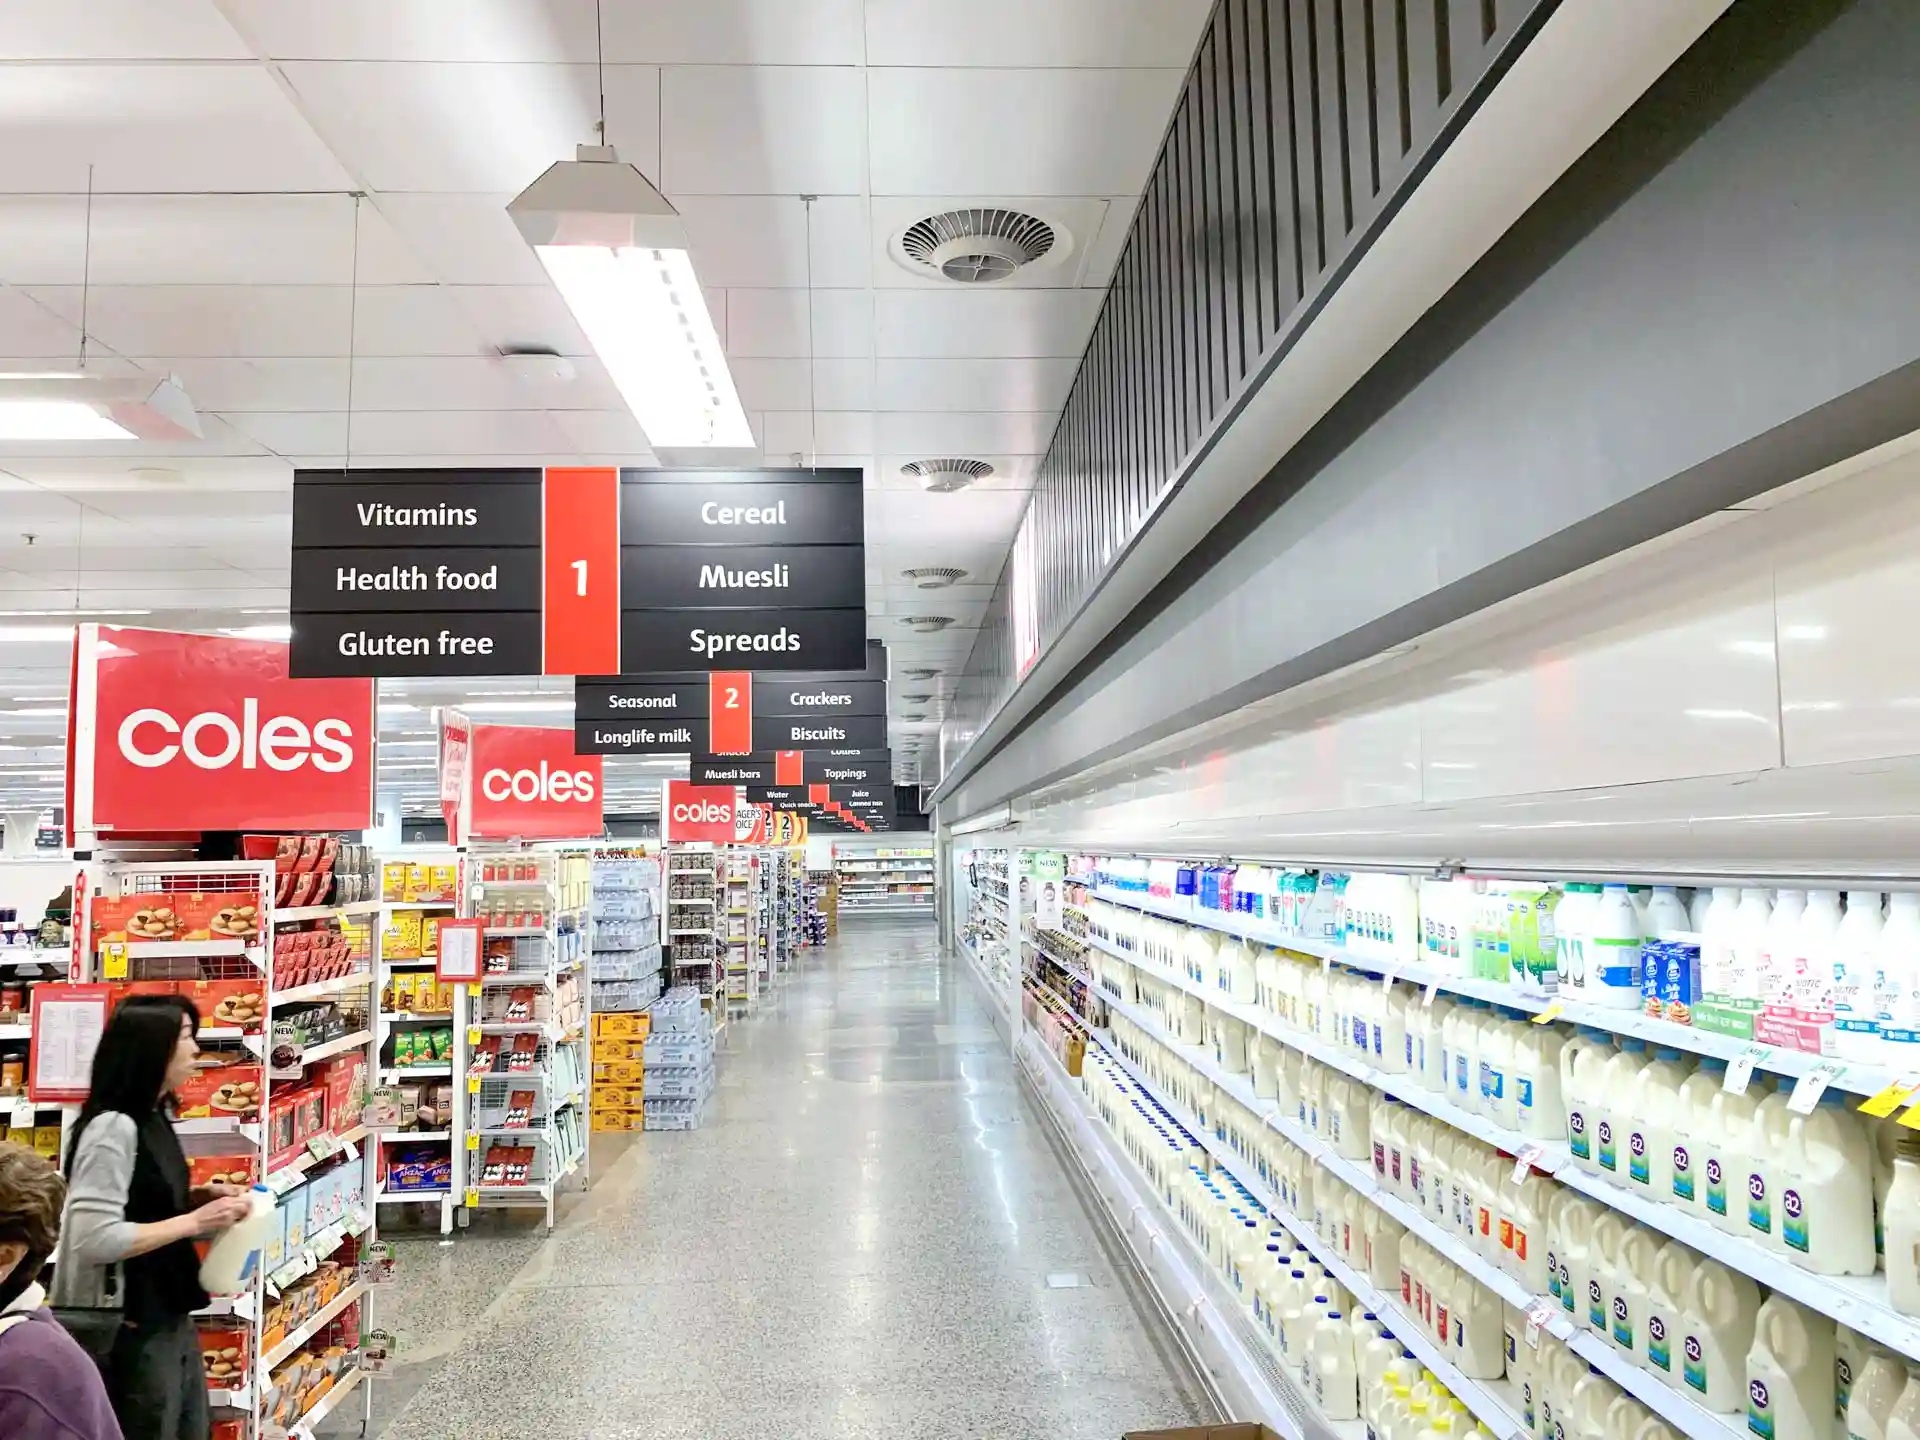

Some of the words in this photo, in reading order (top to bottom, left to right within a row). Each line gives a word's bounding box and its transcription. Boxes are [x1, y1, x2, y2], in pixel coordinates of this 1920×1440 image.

[356, 502, 478, 526] Vitamins
[701, 501, 787, 525] Cereal
[336, 567, 428, 591] Health
[436, 564, 498, 590] food
[571, 559, 589, 596] 1
[698, 563, 789, 588] Muesli
[338, 632, 431, 657] Gluten
[437, 629, 494, 655] free
[690, 627, 801, 658] Spreads
[608, 693, 678, 708] Seasonal
[725, 687, 739, 708] 2
[790, 691, 852, 706] Crackers
[117, 697, 354, 773] coles
[594, 729, 656, 747] Longlife
[659, 728, 692, 742] milk
[791, 727, 846, 741] Biscuits
[482, 760, 595, 803] coles
[705, 769, 737, 779] Muesli
[739, 769, 761, 779] bars
[824, 768, 867, 780] Toppings
[766, 791, 789, 799] Water
[852, 790, 870, 798] Juice
[673, 798, 731, 823] coles
[782, 816, 790, 830] 2
[1040, 859, 1058, 868] NEW
[274, 1027, 295, 1035] NEW
[373, 1089, 391, 1097] NEW
[1571, 1115, 1583, 1132] a2
[1600, 1125, 1611, 1142] a2
[1632, 1138, 1644, 1154] a2
[1674, 1151, 1689, 1168] a2
[1707, 1163, 1721, 1181] a2
[1750, 1179, 1765, 1198] a2
[1784, 1195, 1801, 1213] a2
[1614, 1301, 1627, 1318] a2
[370, 1332, 388, 1340] NEW
[1650, 1321, 1664, 1338] a2
[1687, 1341, 1701, 1359] a2
[1751, 1383, 1767, 1405] a2
